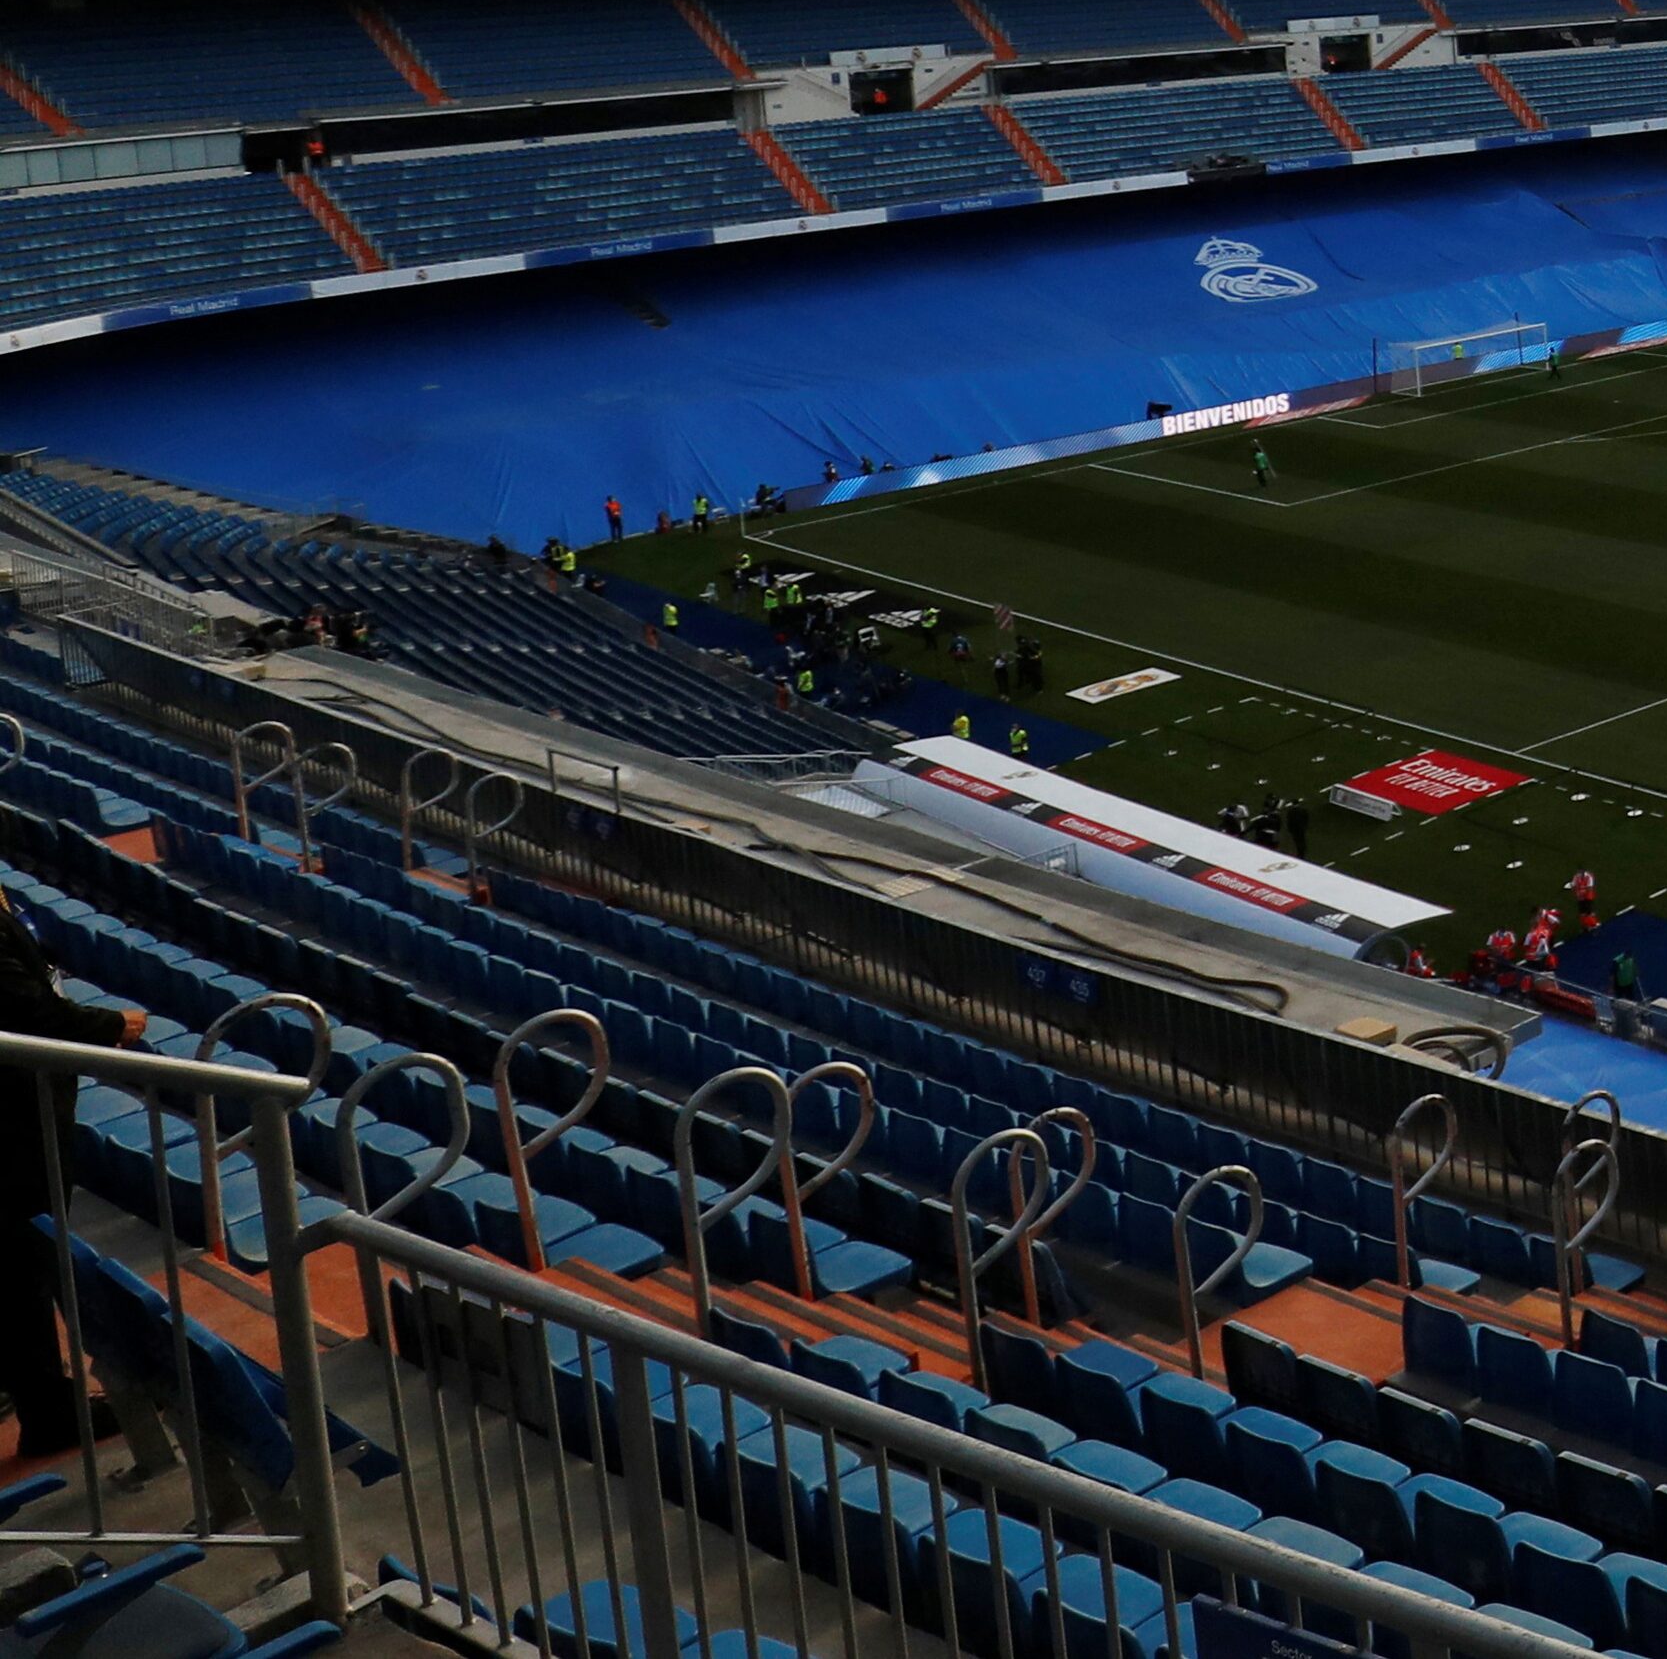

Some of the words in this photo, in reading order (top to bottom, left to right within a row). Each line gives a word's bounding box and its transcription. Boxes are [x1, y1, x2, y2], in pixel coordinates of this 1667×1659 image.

[941, 201, 960, 213] Real
[962, 198, 992, 210] Madrid
[591, 246, 612, 257] Real
[616, 241, 652, 253] Madrid
[170, 305, 195, 316] Real
[198, 298, 238, 313] Madrid
[1162, 393, 1290, 436] BIENVENIDOS
[1399, 759, 1497, 793] Emirates
